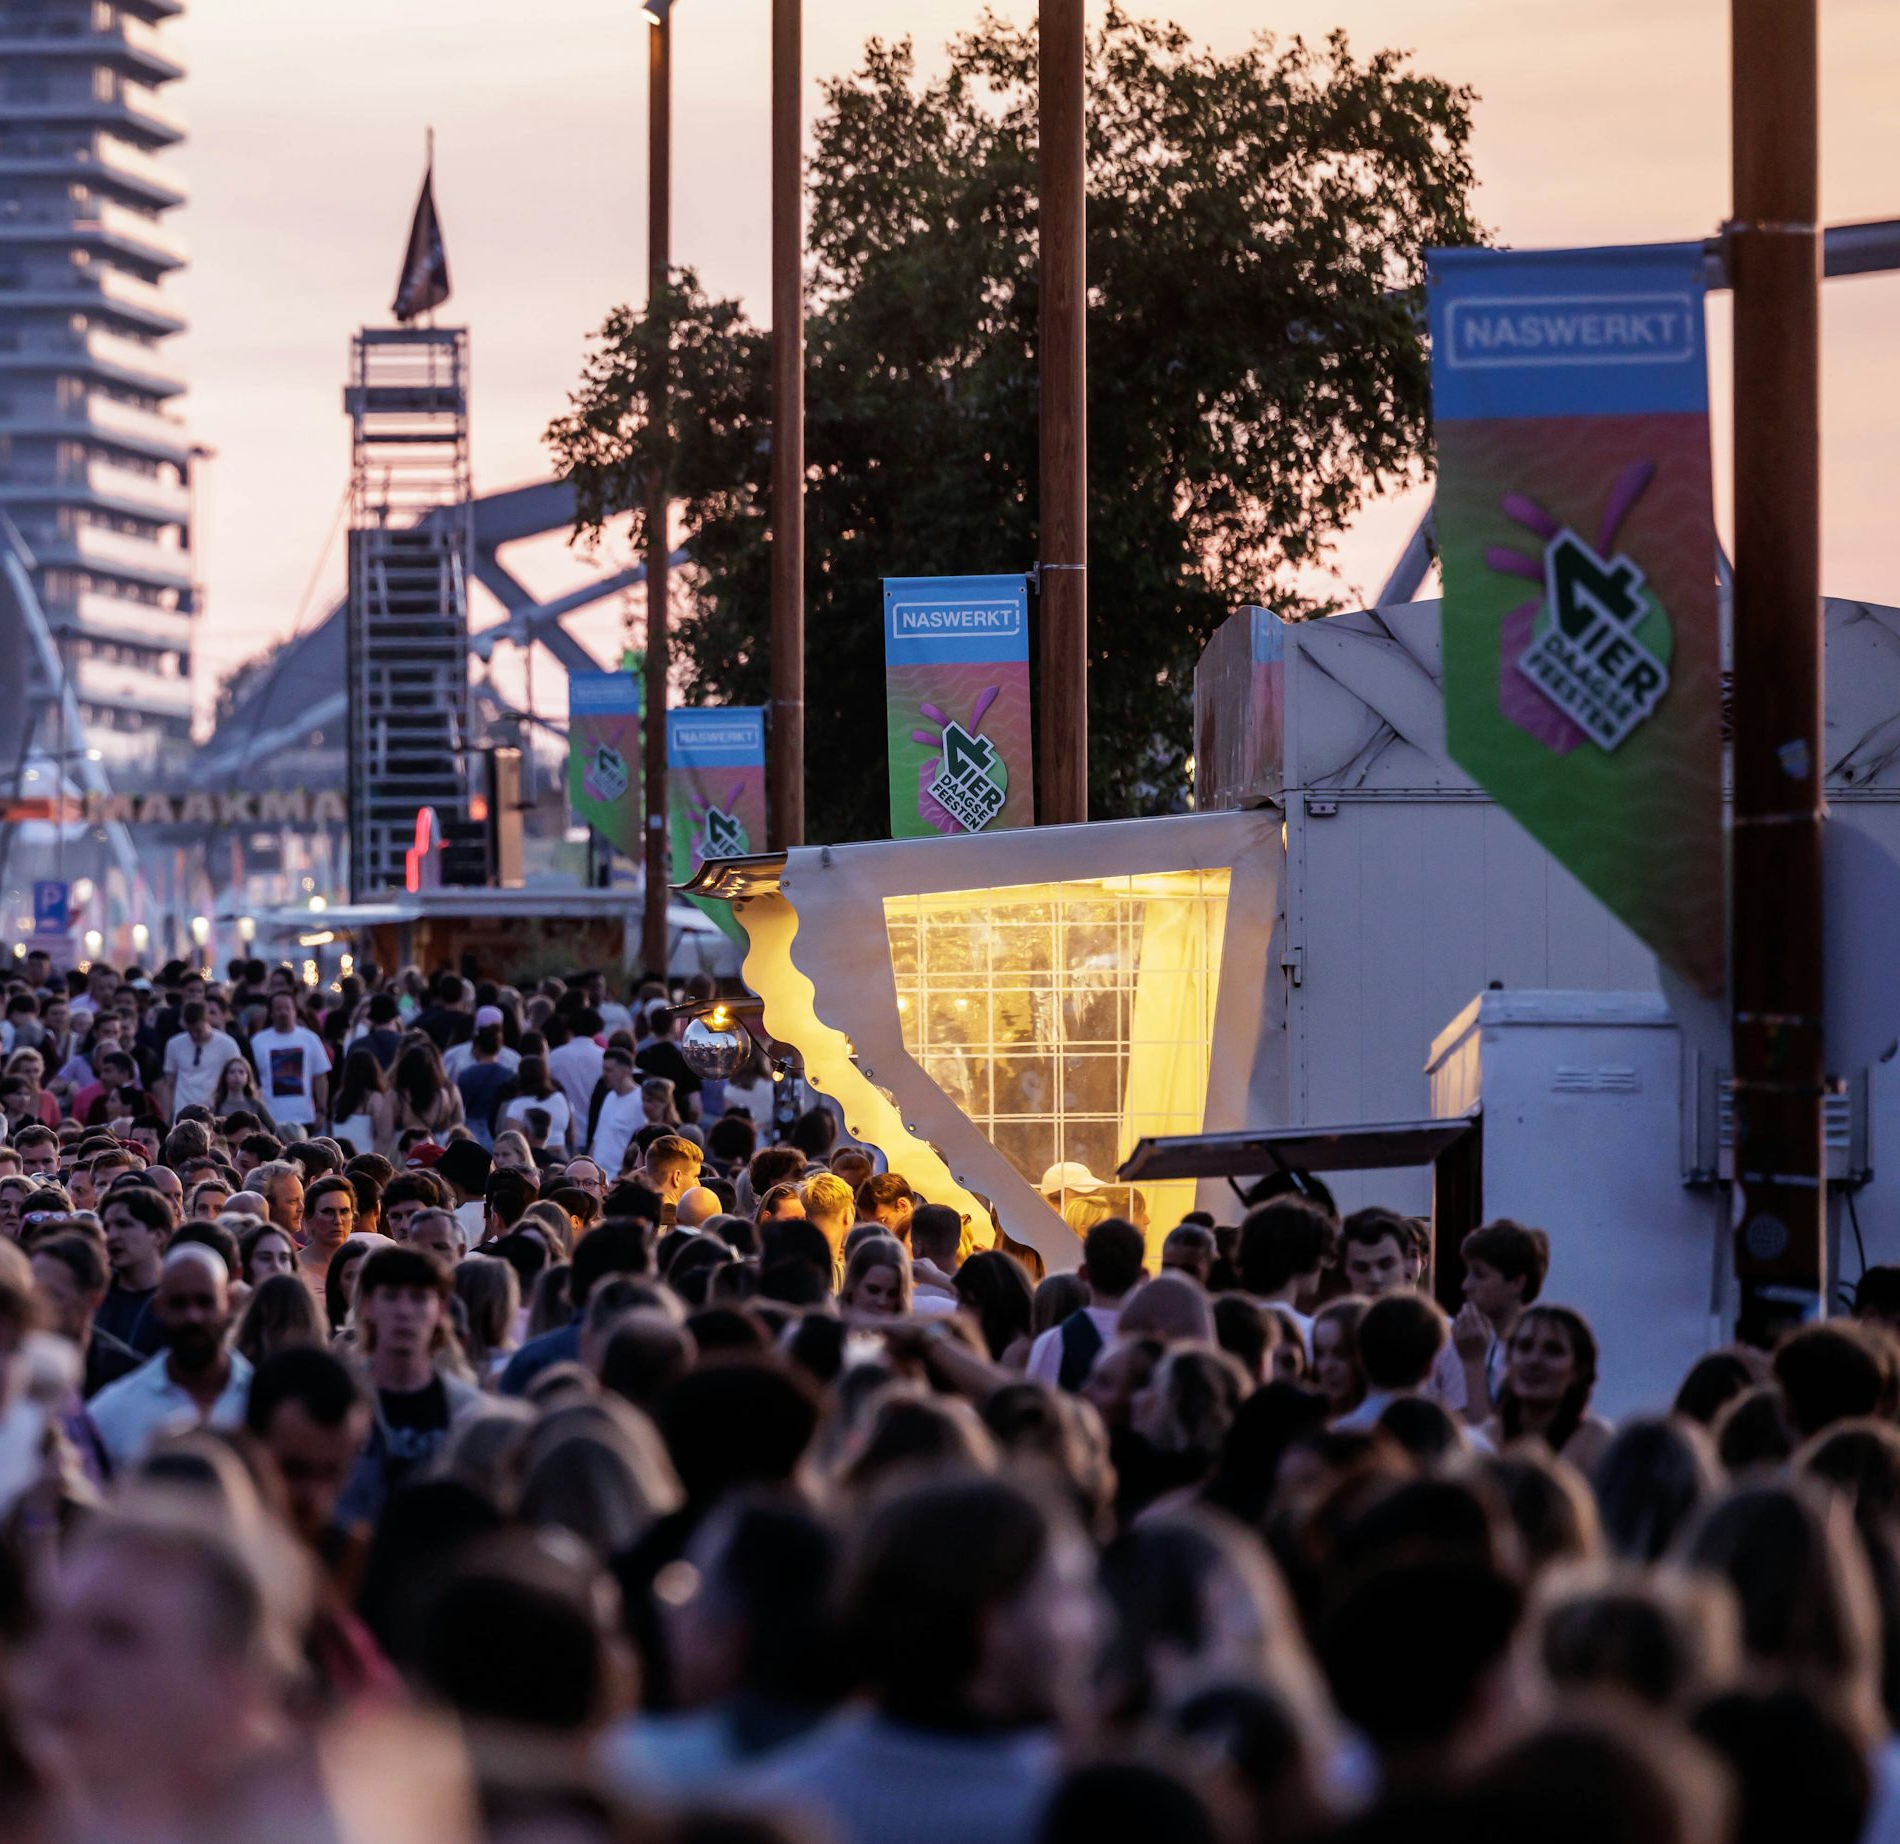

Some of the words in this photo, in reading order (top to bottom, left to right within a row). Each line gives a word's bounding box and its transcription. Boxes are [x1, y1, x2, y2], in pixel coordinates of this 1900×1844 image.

[1464, 312, 1680, 348] NASWERKT
[903, 609, 1012, 628] NASWERKT
[932, 784, 980, 830] FEESTEN
[940, 774, 989, 821] DAAGSE
[43, 886, 61, 911] P
